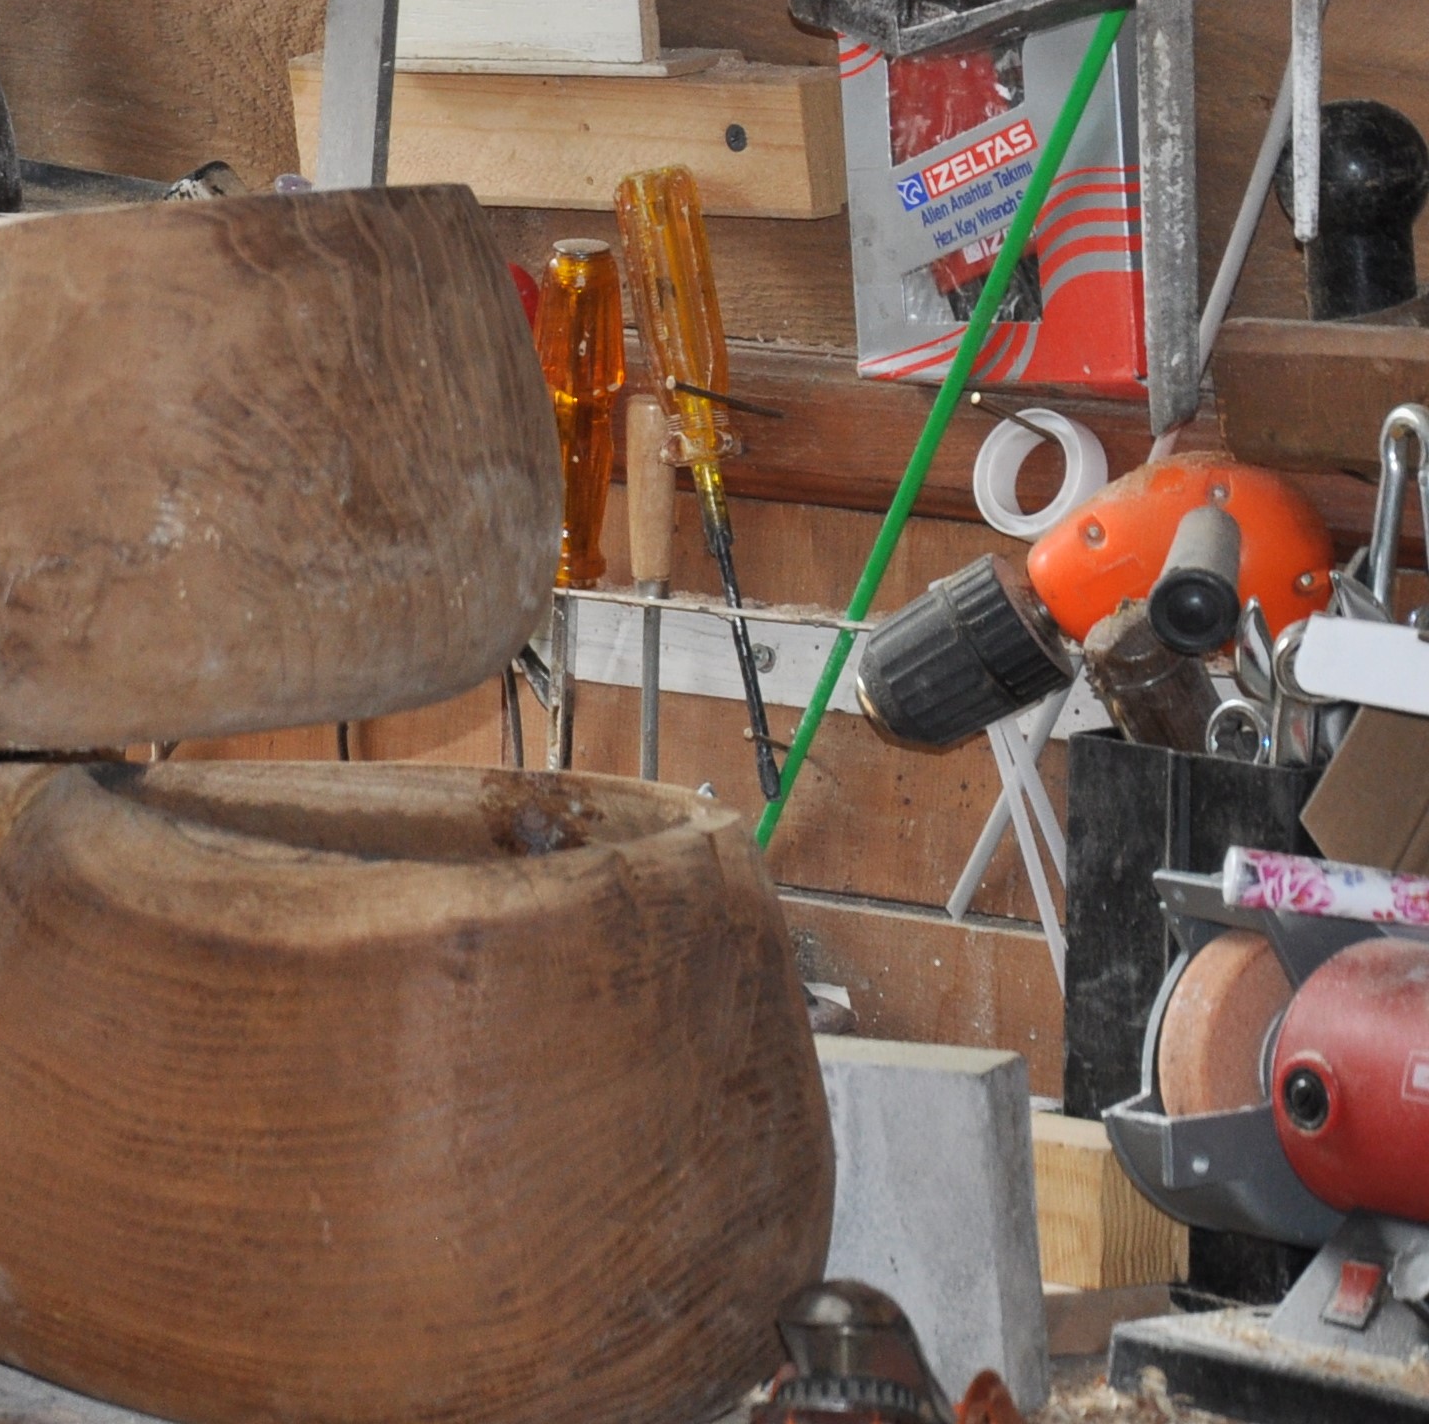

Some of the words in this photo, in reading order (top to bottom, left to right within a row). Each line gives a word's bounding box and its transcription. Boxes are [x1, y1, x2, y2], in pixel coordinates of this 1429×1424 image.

[921, 200, 950, 227] Allen
[949, 180, 995, 213] Anahtar
[955, 217, 978, 236] Key
[976, 196, 1019, 226] Wrench
